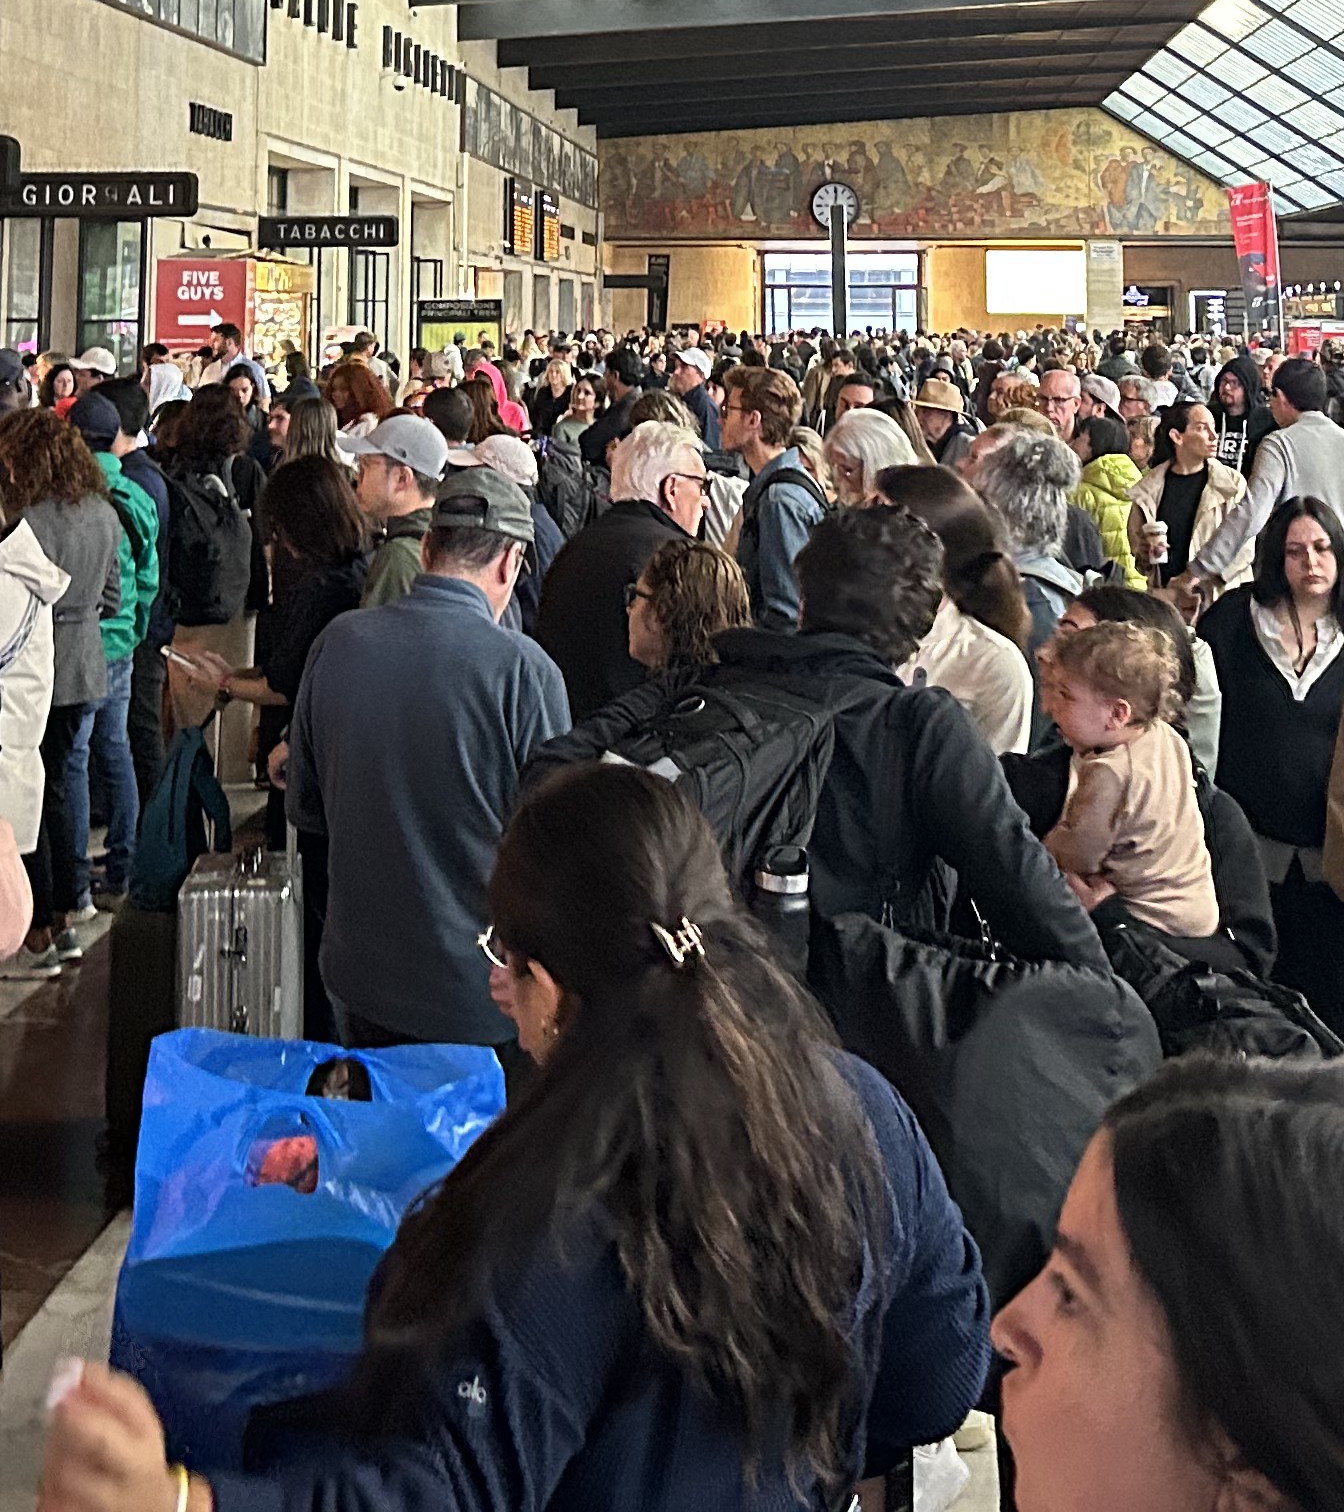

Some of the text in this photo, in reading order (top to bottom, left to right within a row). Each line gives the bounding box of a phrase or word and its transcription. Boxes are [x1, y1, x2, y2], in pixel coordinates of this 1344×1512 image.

[278, 223, 385, 239] TABACCHI
[182, 271, 220, 285] FIVE
[177, 286, 224, 301] GUYS
